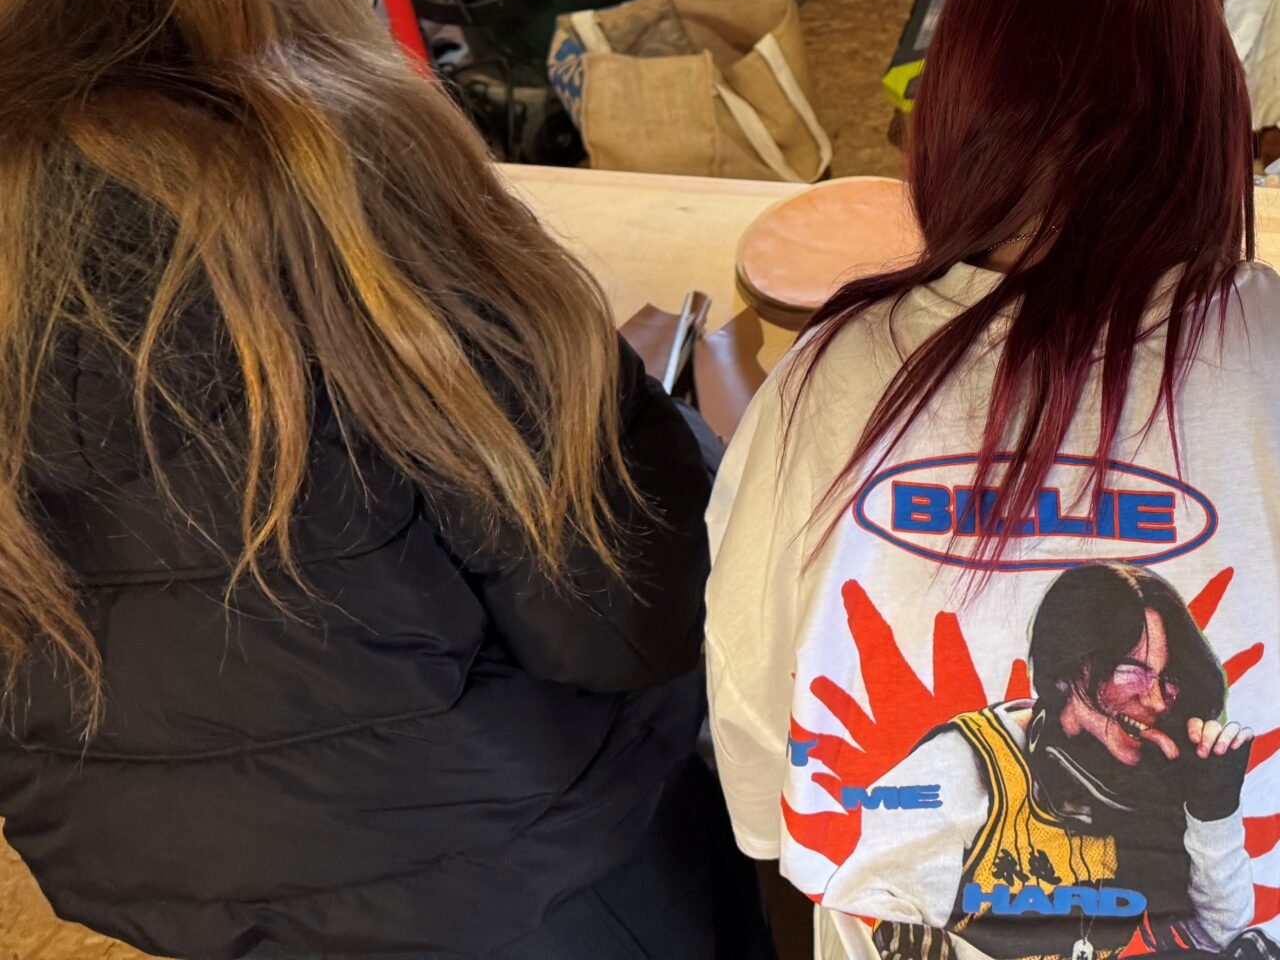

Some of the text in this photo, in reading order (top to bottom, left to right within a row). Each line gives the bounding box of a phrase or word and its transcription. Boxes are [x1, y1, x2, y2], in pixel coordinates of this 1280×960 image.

[890, 480, 1177, 544] BILLIE
[841, 784, 943, 810] ME
[962, 882, 1147, 917] HARD
